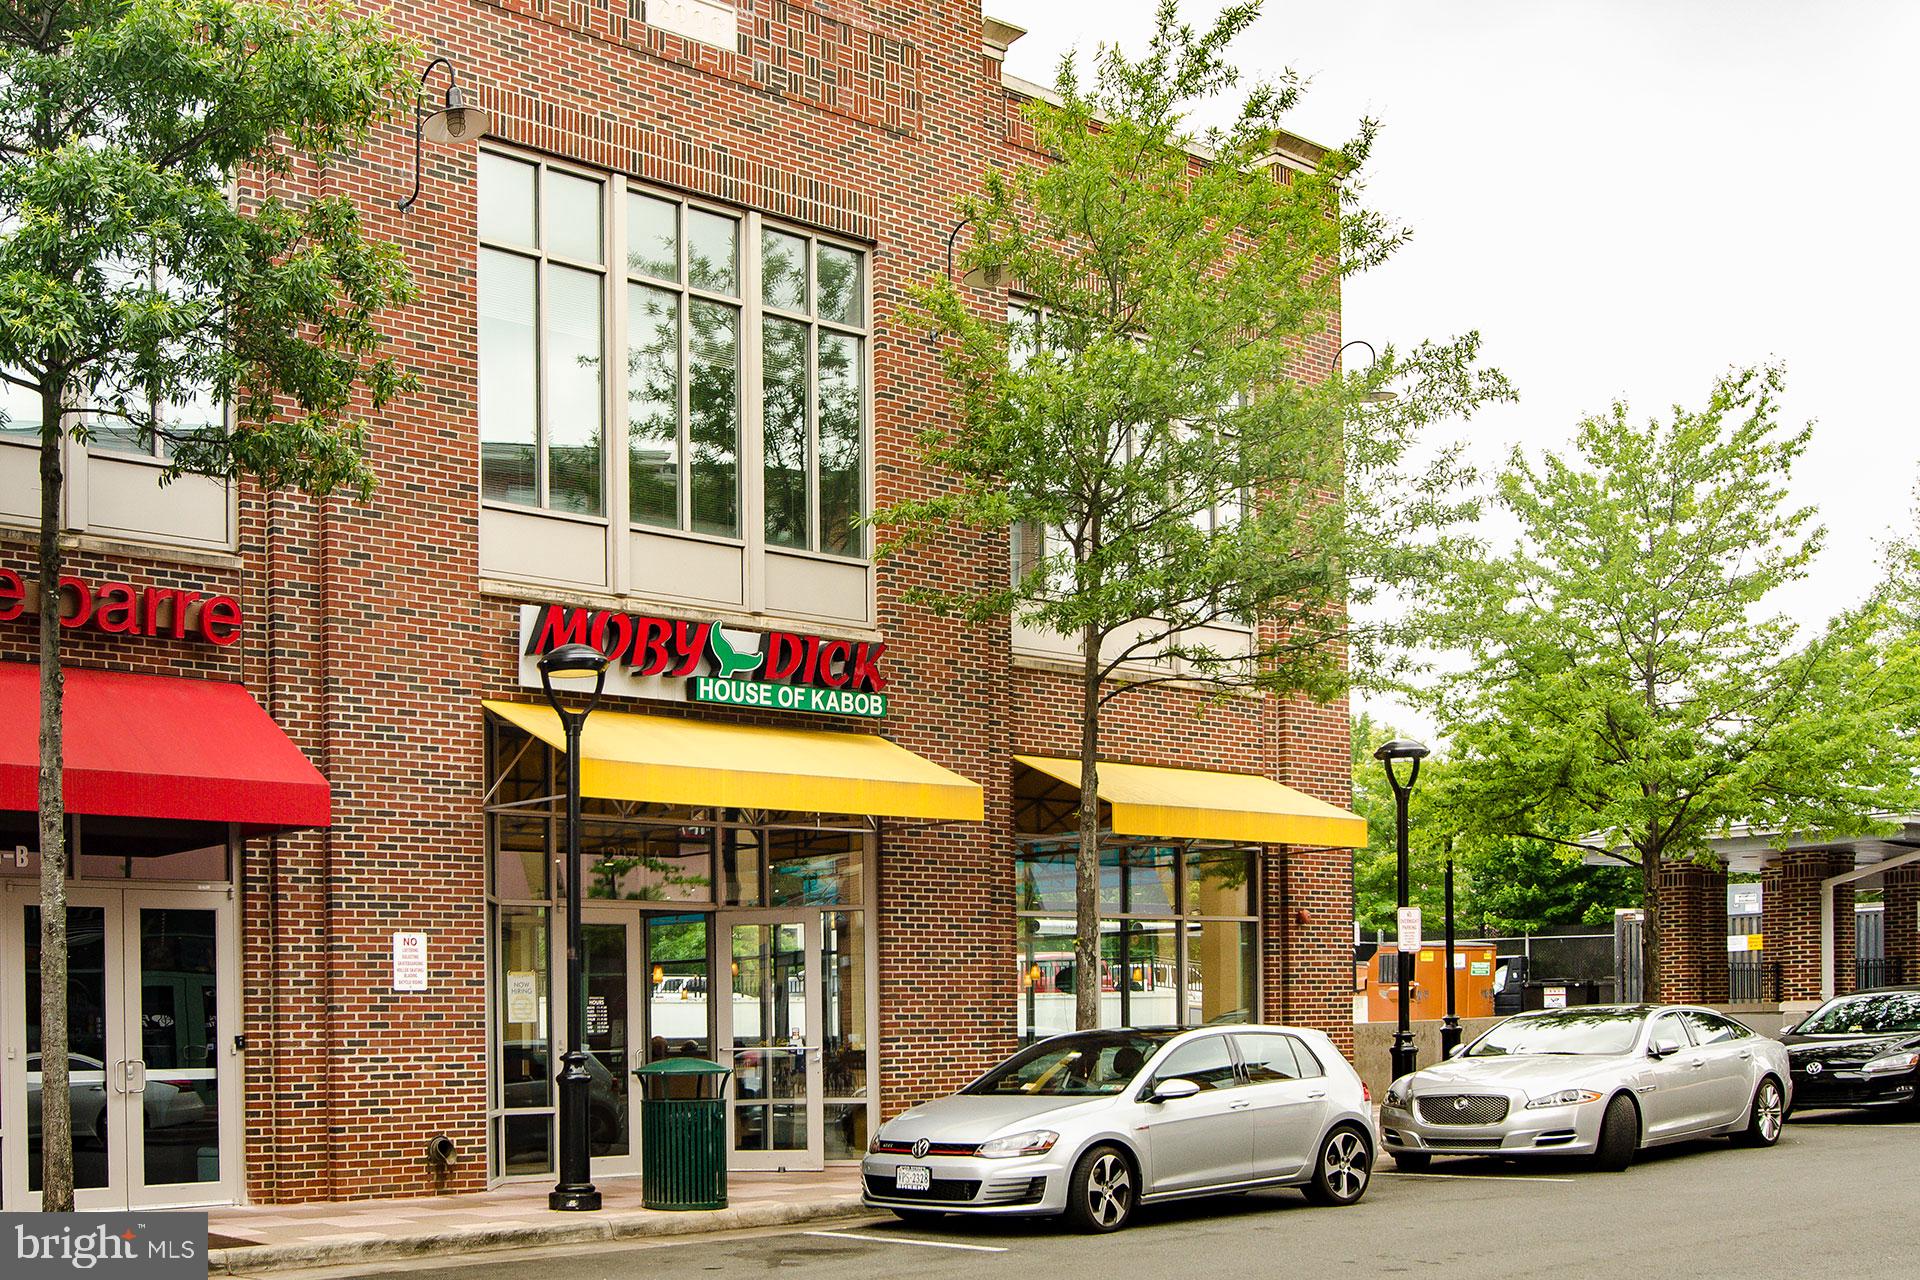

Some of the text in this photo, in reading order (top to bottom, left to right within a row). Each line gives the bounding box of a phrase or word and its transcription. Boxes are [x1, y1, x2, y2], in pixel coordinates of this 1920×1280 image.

[528, 603, 887, 694] MOBY DICK
[699, 677, 883, 717] HOUSE OF KABOB
[403, 937, 418, 946] NO
